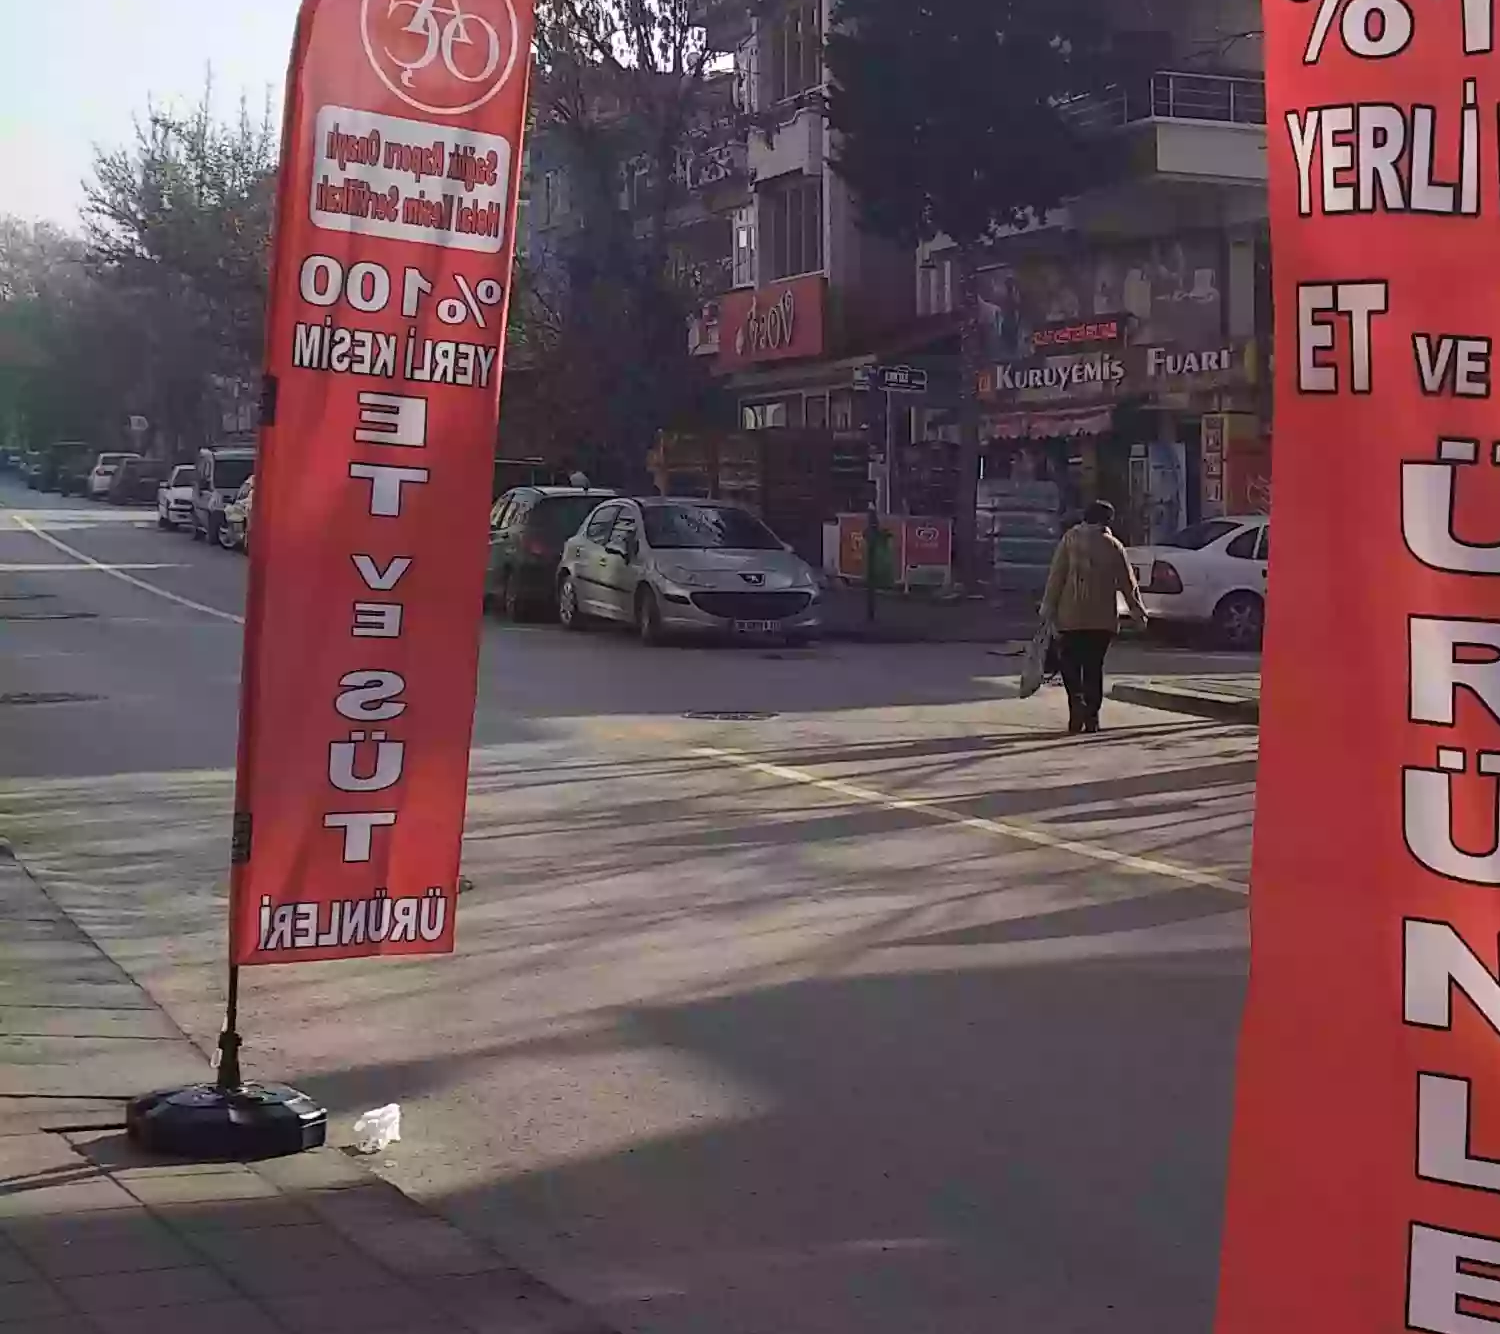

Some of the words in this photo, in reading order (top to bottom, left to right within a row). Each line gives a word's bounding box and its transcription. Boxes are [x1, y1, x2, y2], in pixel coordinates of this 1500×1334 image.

[1285, 77, 1481, 216] YERLİ
[996, 354, 1125, 392] KURUYEMİŞ
[1296, 279, 1389, 395] ET
[1411, 333, 1492, 397] VE
